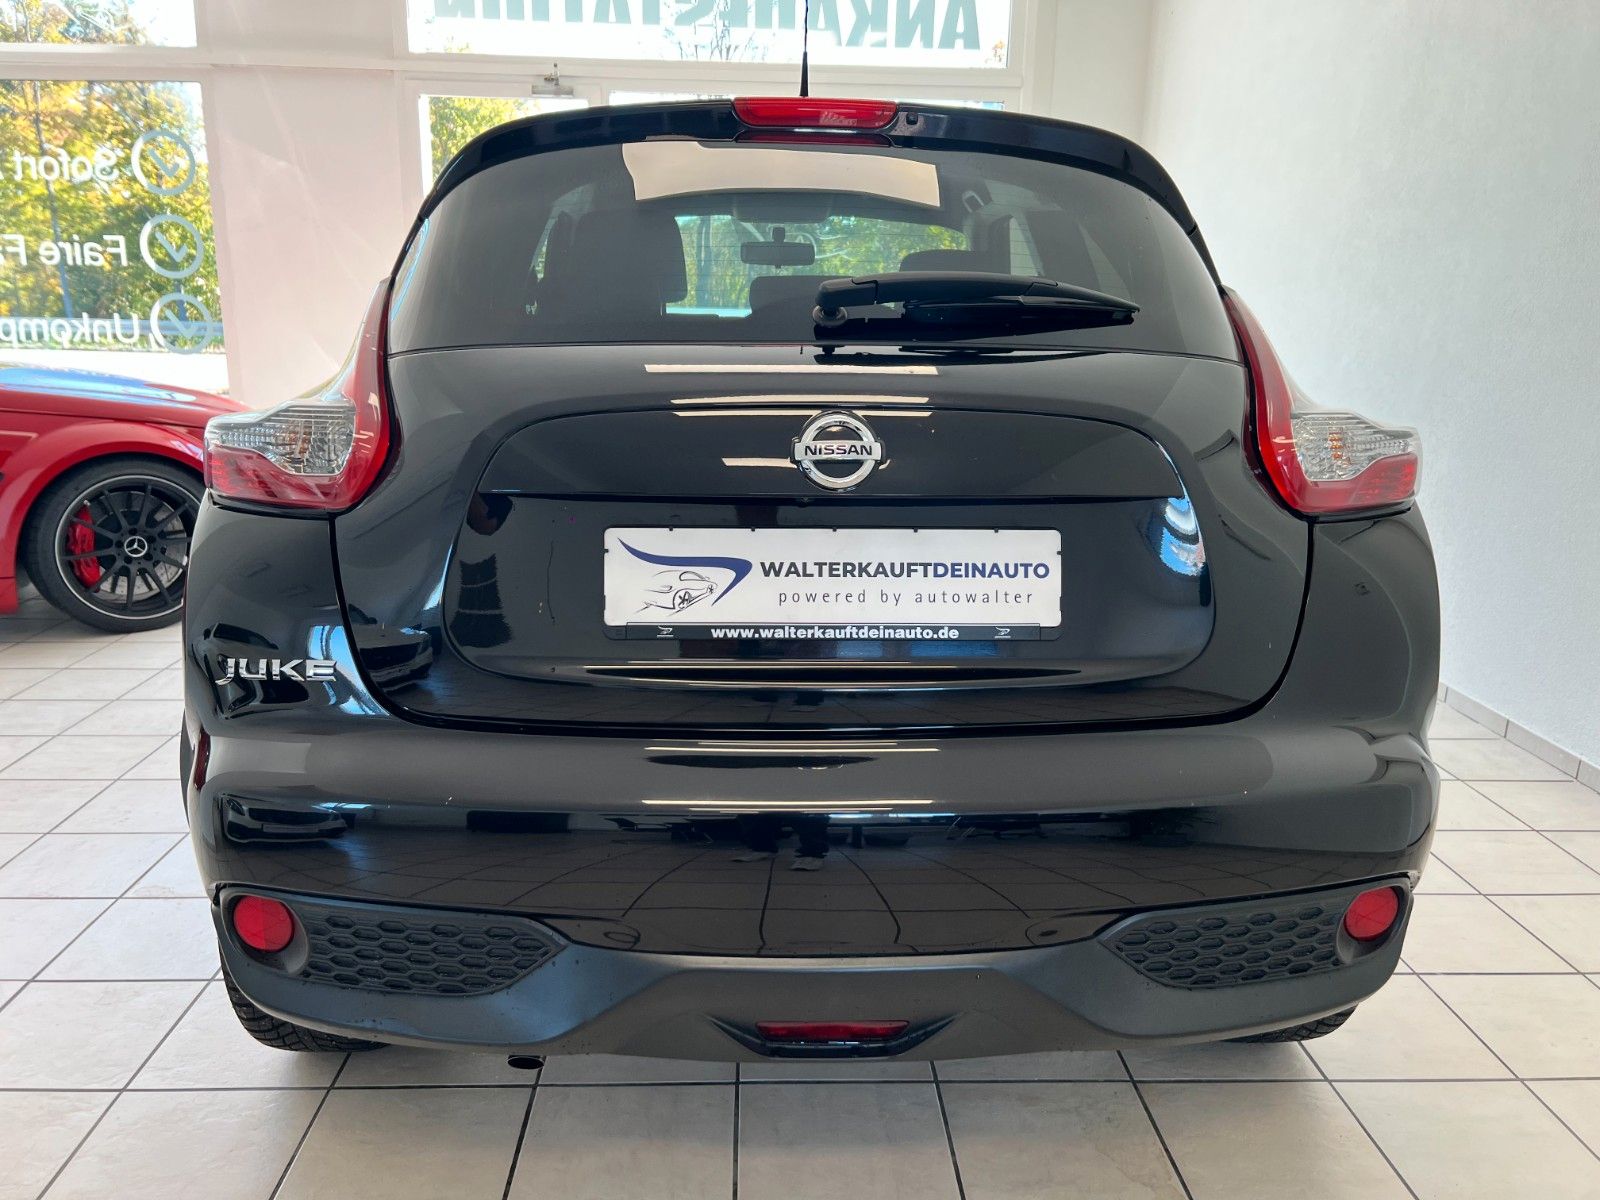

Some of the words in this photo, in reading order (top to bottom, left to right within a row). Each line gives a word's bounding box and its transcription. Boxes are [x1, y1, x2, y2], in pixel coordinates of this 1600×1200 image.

[804, 444, 873, 456] NISSAN
[760, 561, 1050, 579] WALTERKAUFTDEINAUTO
[778, 589, 867, 606] powered
[880, 589, 902, 606] by
[914, 589, 1034, 604] autowalter
[710, 625, 960, 640] www.walterkauftdeinauto.de
[214, 658, 337, 686] JUKE
